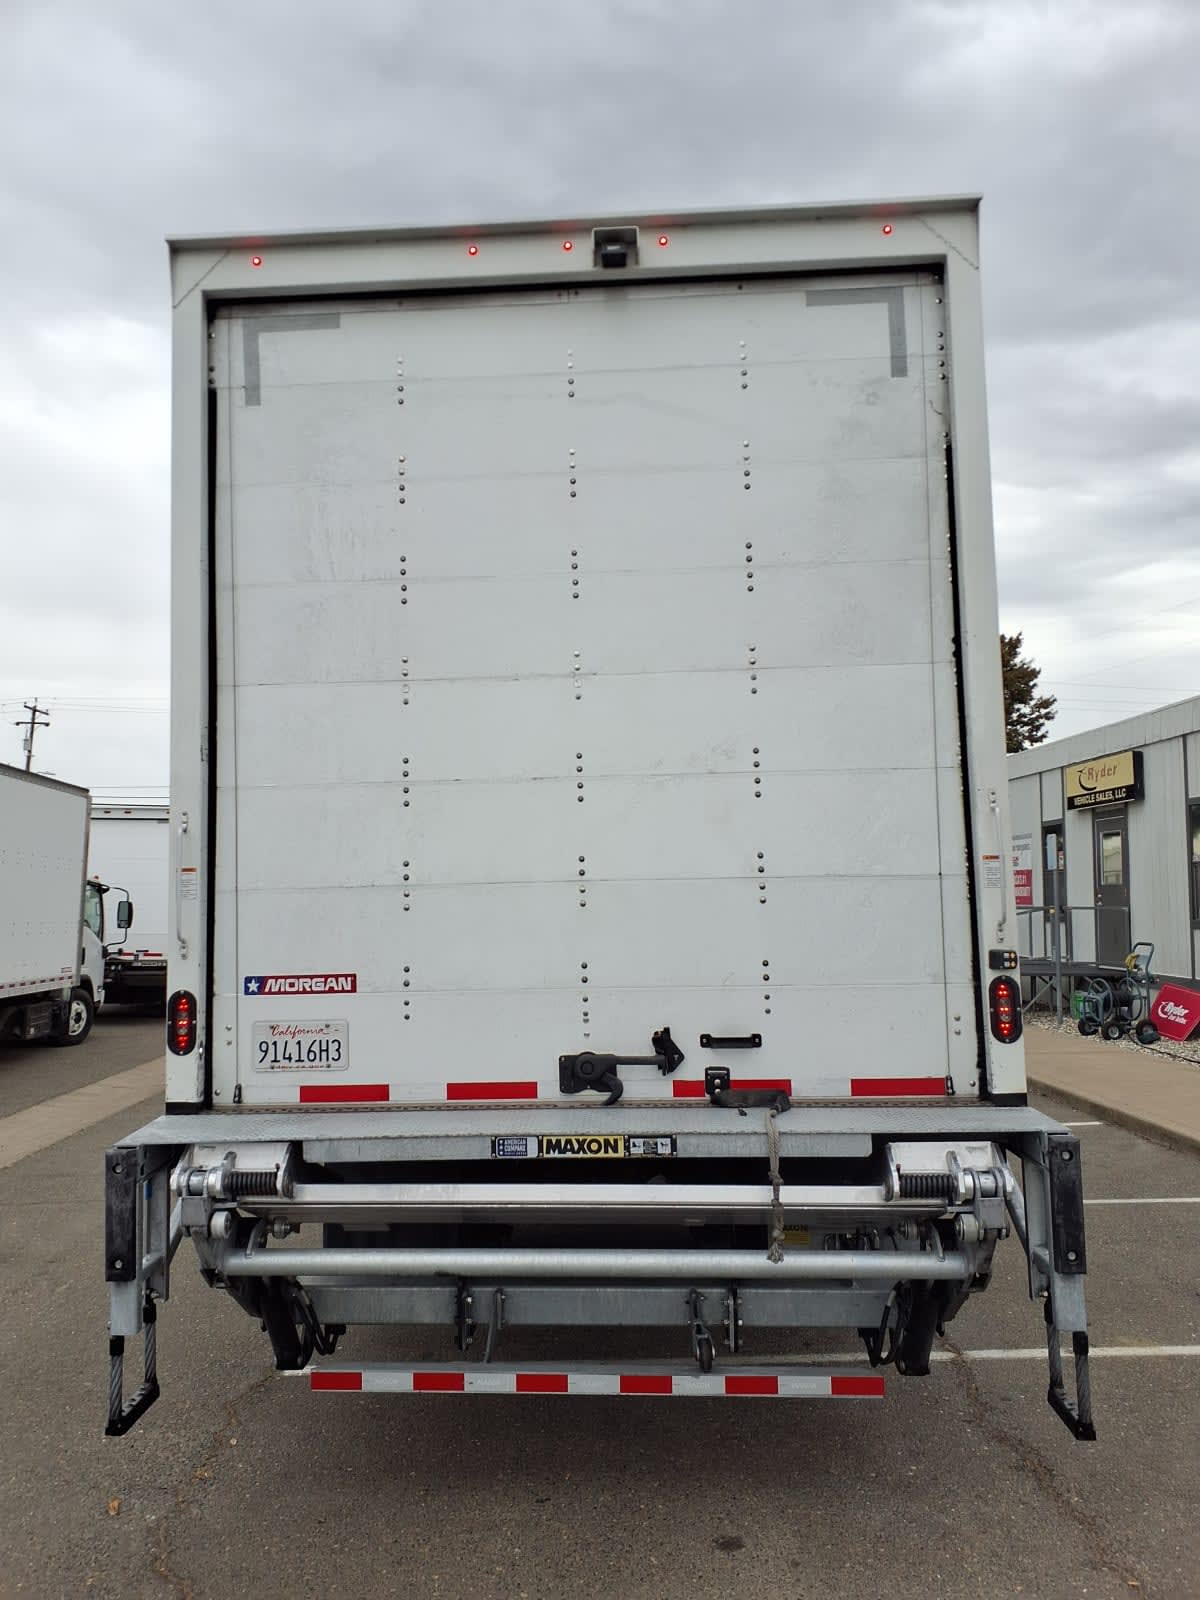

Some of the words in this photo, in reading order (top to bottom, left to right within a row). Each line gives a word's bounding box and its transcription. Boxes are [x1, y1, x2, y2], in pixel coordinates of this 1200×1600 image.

[1087, 763, 1118, 782] Ryder
[1074, 793, 1095, 806] VEHICLE
[1115, 788, 1126, 799] LLC
[264, 977, 352, 992] MORGAN
[1166, 1001, 1190, 1016] Ryder
[271, 1024, 325, 1039] California
[259, 1039, 341, 1064] 91416H3
[545, 1138, 618, 1154] MAXON
